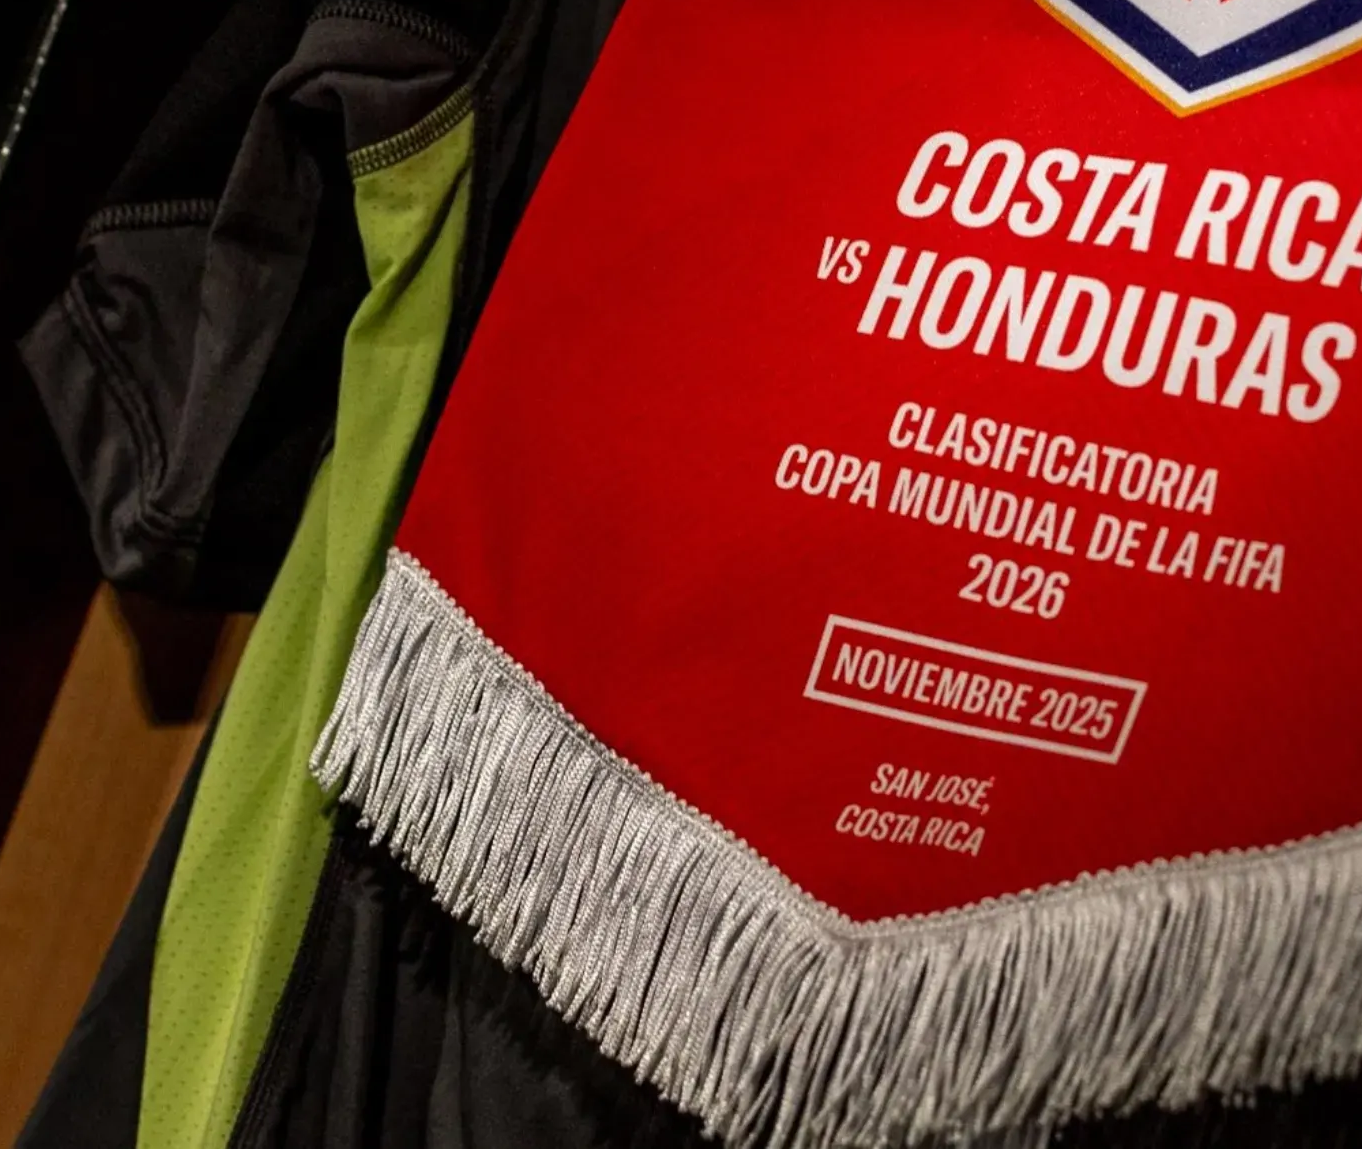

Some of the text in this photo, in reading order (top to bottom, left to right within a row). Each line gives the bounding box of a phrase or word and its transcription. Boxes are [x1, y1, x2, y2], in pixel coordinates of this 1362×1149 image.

[895, 130, 1169, 253] COSTA
[816, 235, 1358, 424] VS HONDURAS
[887, 401, 1219, 516] CLASIFICATORIA
[774, 443, 1286, 593] COPA MUNDIAL DE LA FIFA
[958, 553, 1071, 620] 2026
[831, 642, 1119, 740] NOVIEMBRE 2025
[835, 804, 986, 857] COSTA RICA
[870, 763, 994, 815] SAN JOSÉ,
